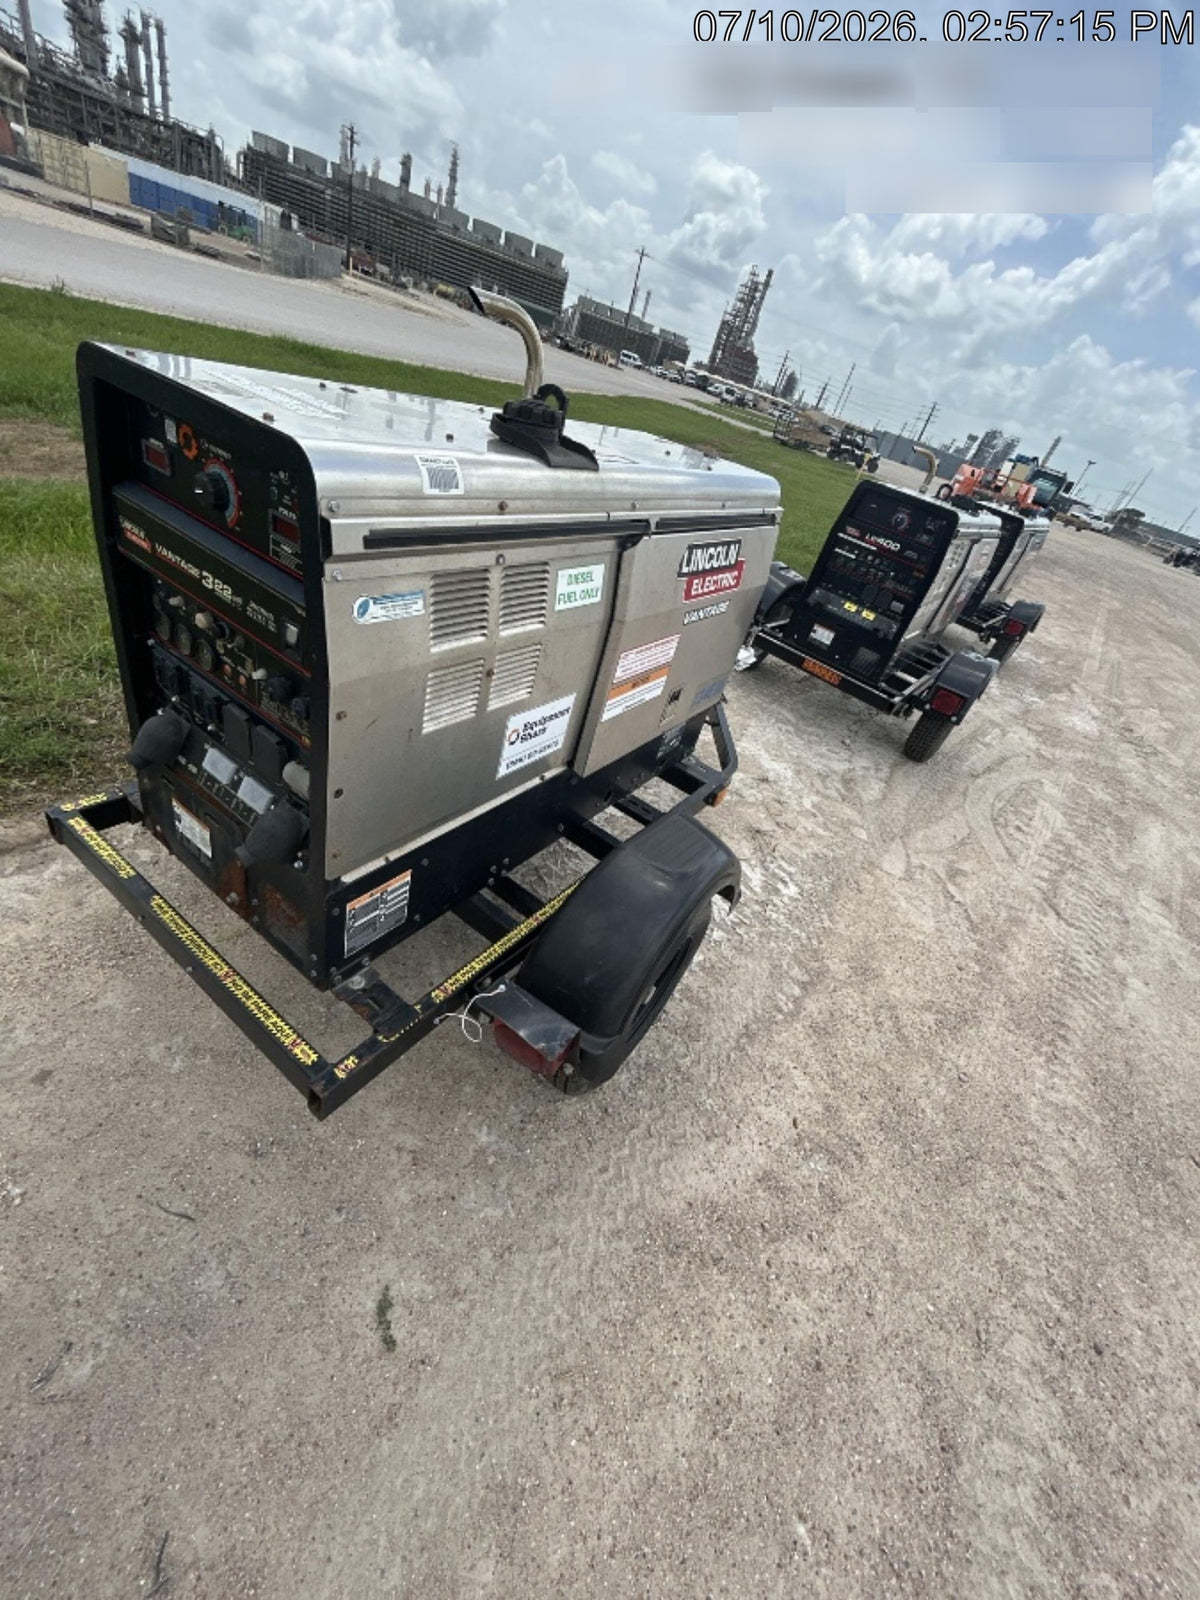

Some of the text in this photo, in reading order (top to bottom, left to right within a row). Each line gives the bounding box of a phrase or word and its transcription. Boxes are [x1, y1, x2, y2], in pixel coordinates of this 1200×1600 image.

[681, 543, 740, 573] LINCOLN
[154, 542, 233, 600] VANTAGE 322
[567, 571, 594, 586] DIESEL
[690, 571, 739, 596] ELECTRIC
[557, 587, 600, 606] FUEL ONLY
[683, 600, 731, 625] VANTAGE
